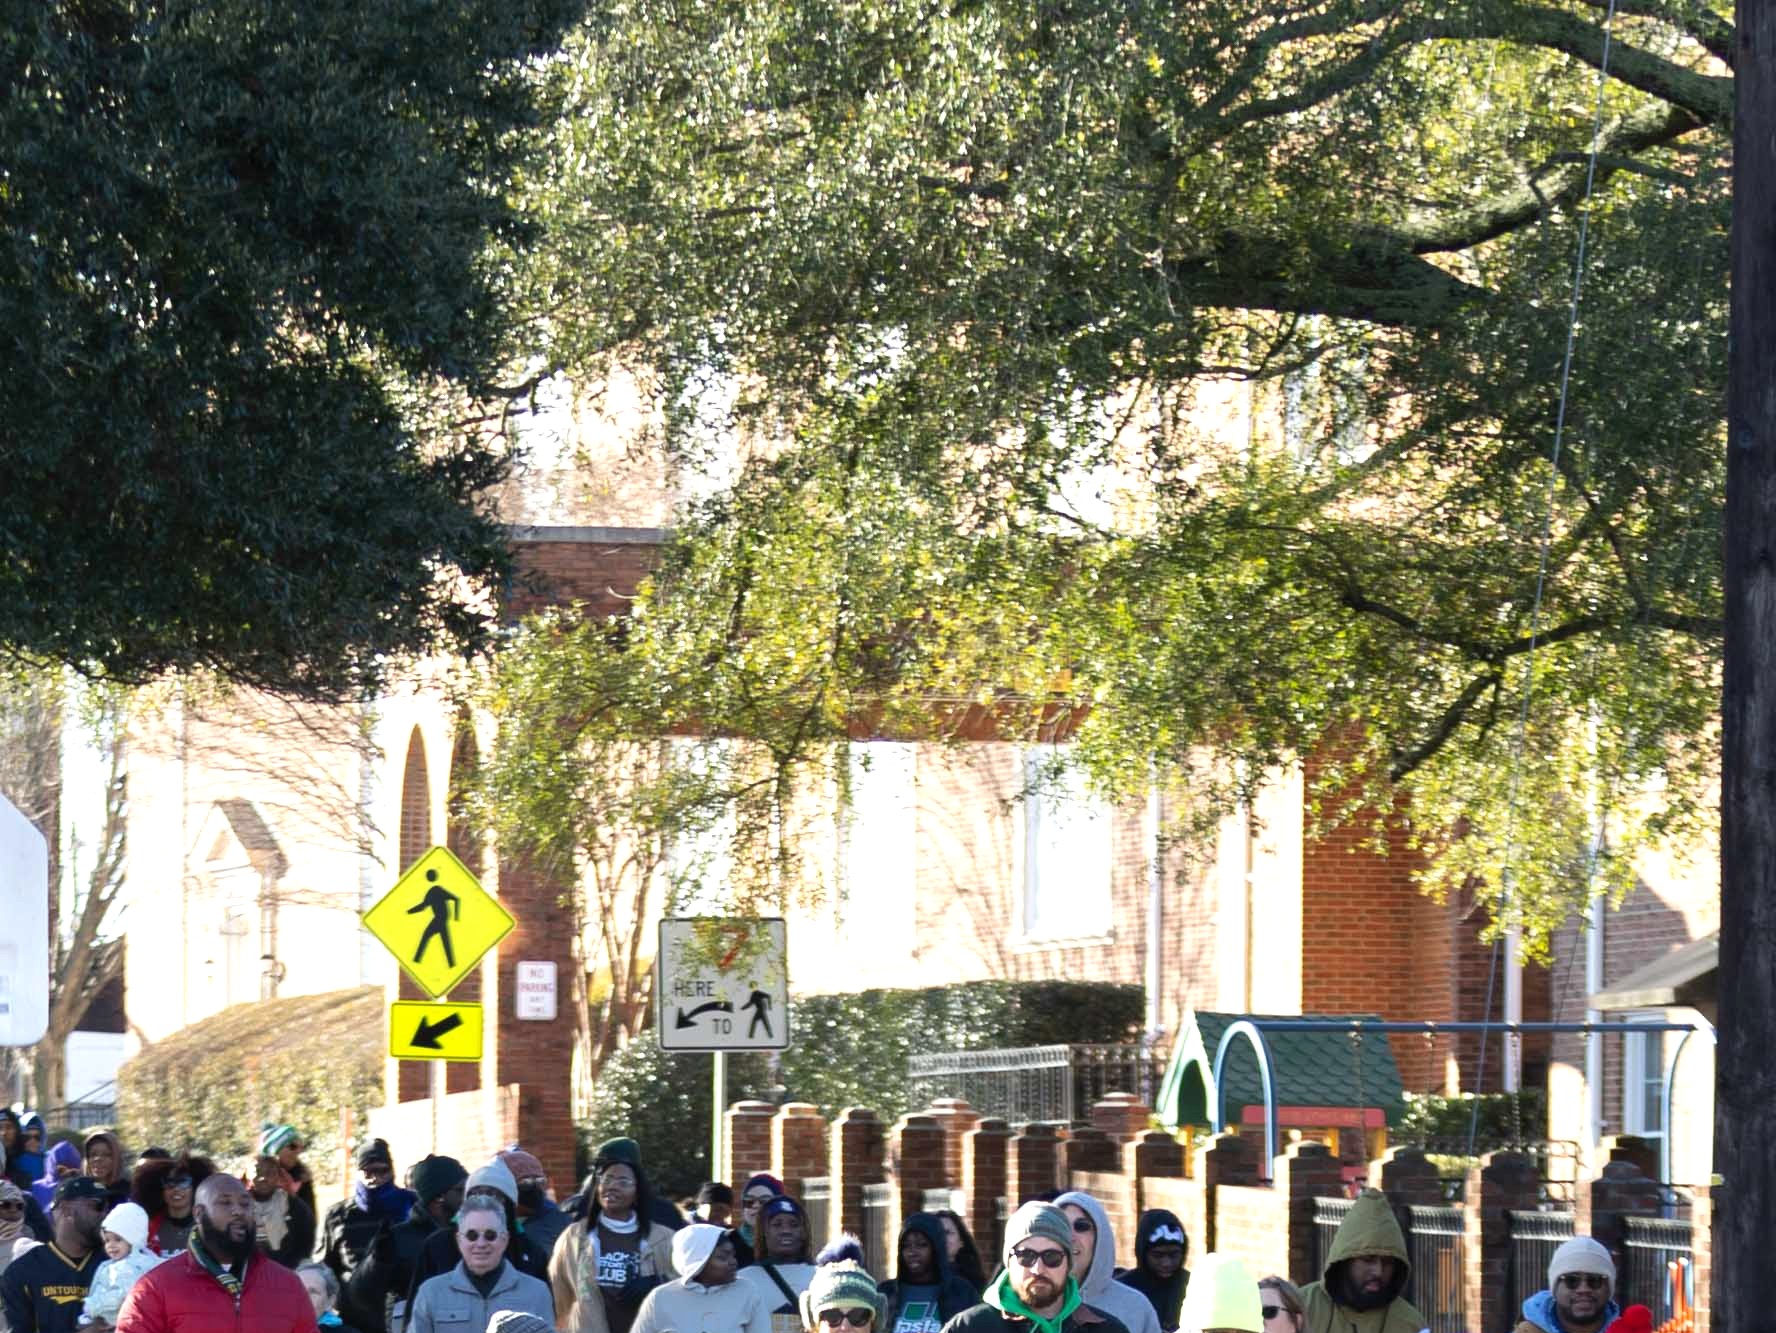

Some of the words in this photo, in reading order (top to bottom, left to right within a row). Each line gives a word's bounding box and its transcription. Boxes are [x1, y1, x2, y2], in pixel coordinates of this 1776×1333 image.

[674, 981, 716, 997] HERE
[712, 1018, 732, 1034] TO
[596, 1268, 626, 1282] LUB
